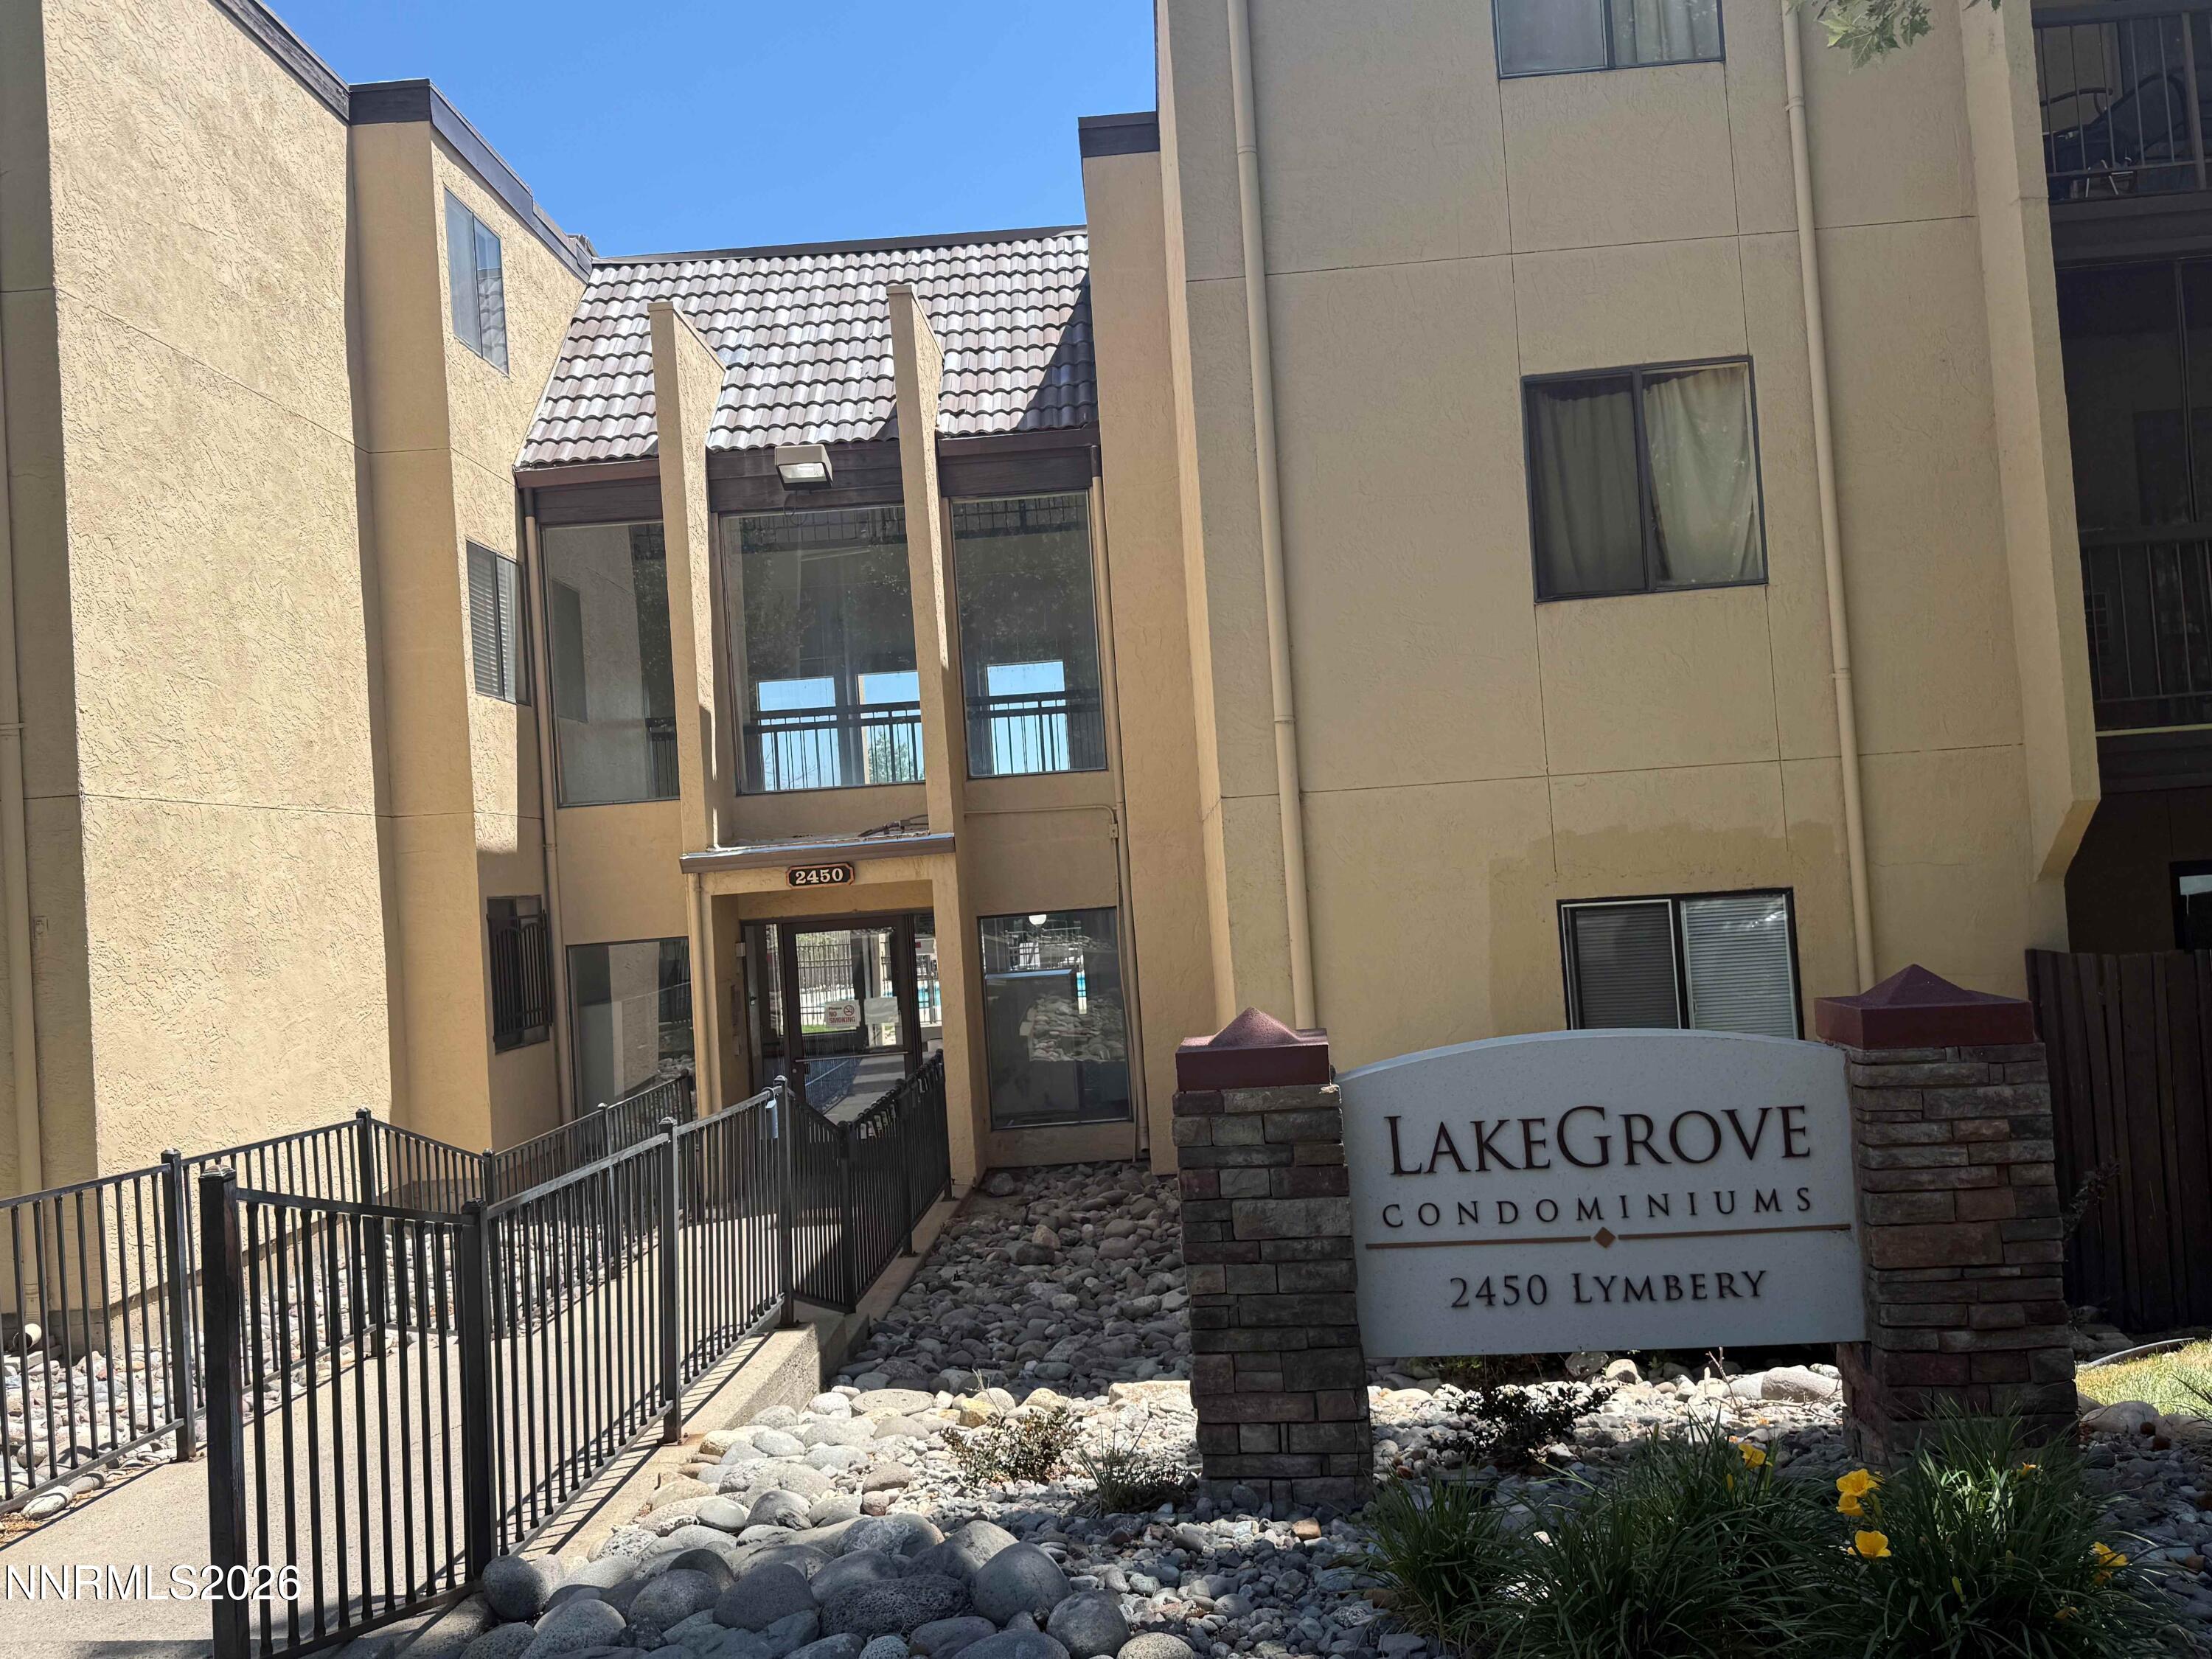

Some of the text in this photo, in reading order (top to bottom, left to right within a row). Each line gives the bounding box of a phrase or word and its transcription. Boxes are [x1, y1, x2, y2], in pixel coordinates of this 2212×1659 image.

[796, 868, 844, 884] 2450
[1382, 1187, 1812, 1228] CONDOMINIUMS
[1450, 1270, 1767, 1309] 2450 LYMBERY
